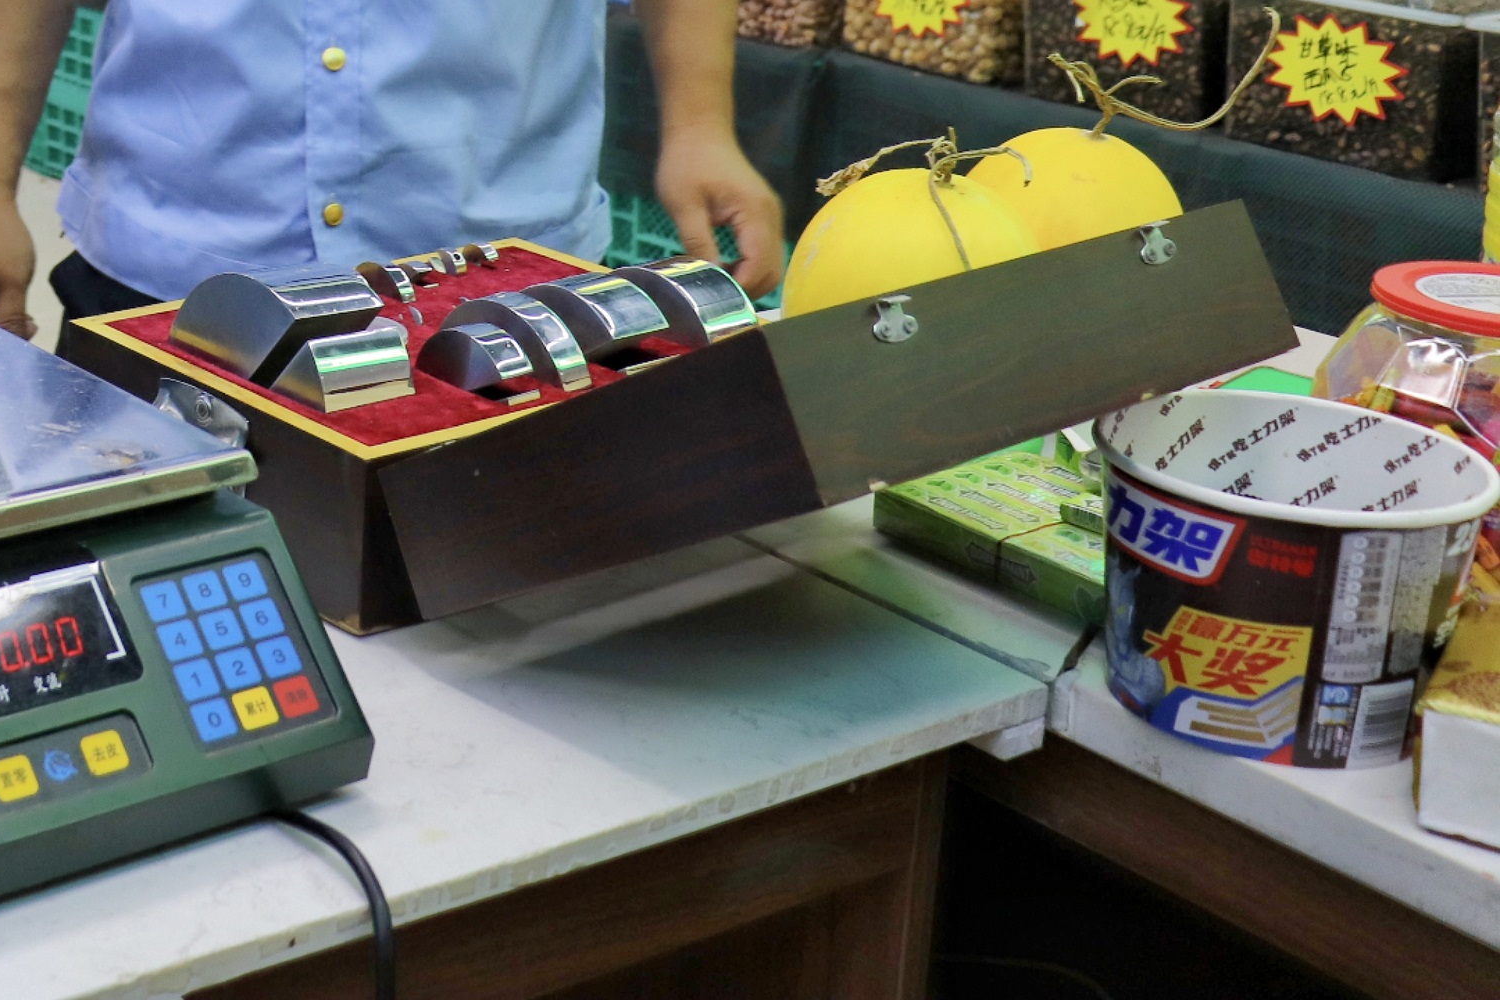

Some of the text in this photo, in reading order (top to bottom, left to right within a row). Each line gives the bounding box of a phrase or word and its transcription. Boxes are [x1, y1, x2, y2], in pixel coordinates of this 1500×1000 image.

[1383, 435, 1440, 474] 饿了就吃士
[238, 573, 251, 587] 9
[199, 584, 212, 598] 8
[156, 594, 168, 608] 7
[255, 610, 269, 626] 6
[214, 621, 229, 636] 5
[174, 632, 188, 647] 4
[272, 649, 287, 664] 3
[1143, 628, 1293, 696] 大奖
[232, 660, 248, 677] 2
[190, 672, 201, 686] 1
[244, 700, 269, 717] 累计
[207, 712, 222, 728] 0
[92, 740, 120, 761] 去皮
